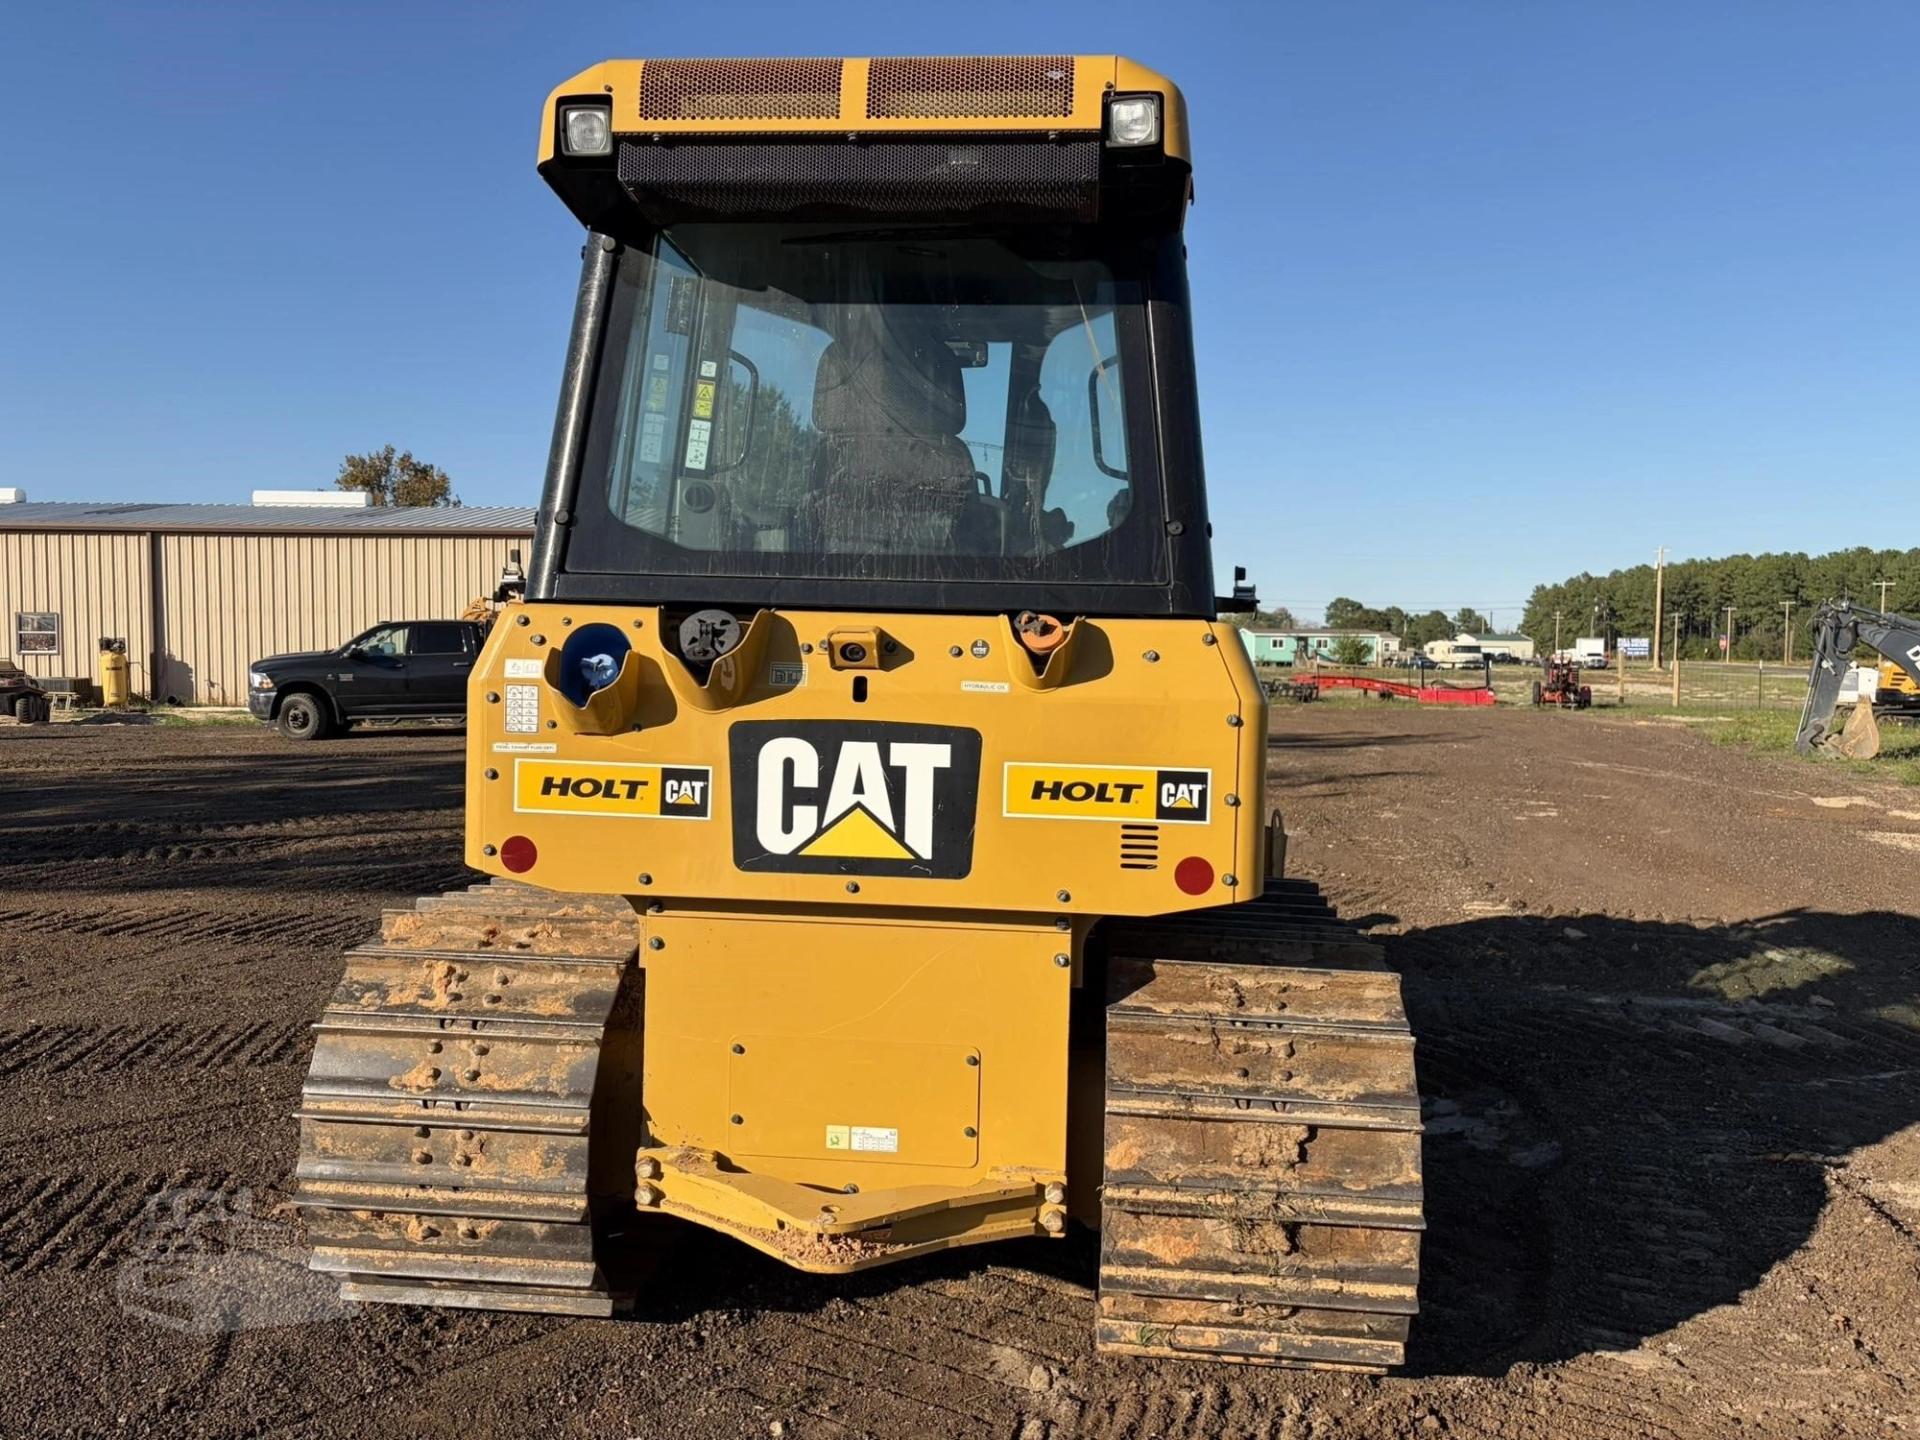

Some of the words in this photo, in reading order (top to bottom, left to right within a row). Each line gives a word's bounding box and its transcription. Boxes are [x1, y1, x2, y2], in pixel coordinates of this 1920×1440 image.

[541, 776, 649, 800] HOLT
[665, 779, 705, 805] CAT
[756, 737, 952, 860] CAT
[1031, 780, 1144, 804] HOLT
[1161, 782, 1203, 809] CAT
